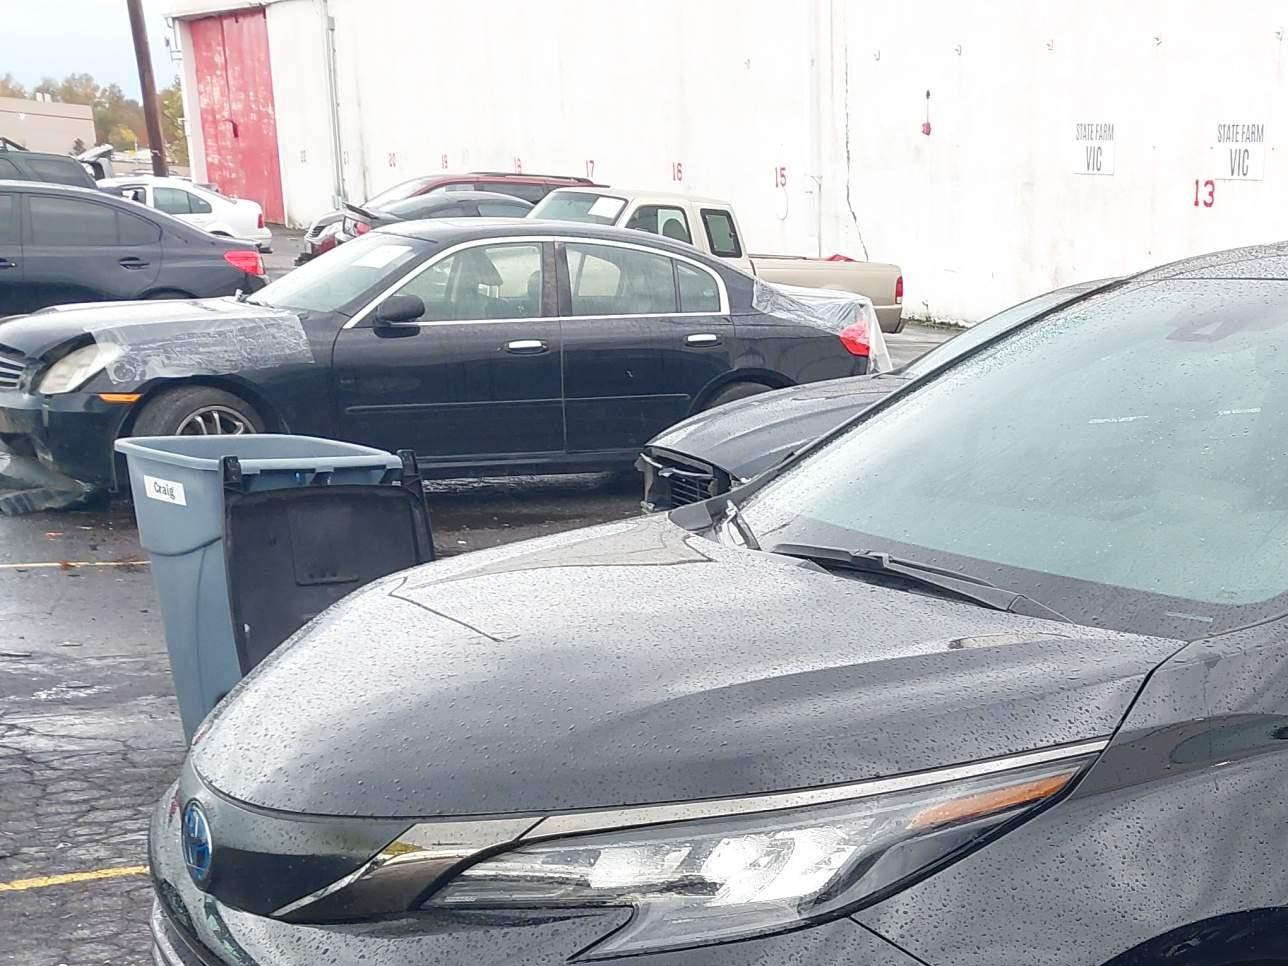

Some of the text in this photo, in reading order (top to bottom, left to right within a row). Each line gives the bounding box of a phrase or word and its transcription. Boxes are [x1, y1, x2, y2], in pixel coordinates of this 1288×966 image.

[1076, 123, 1114, 141] STATE FARM
[1217, 124, 1264, 143] STATE FARM
[585, 159, 595, 178] 17
[1085, 146, 1102, 172] VIC
[1229, 149, 1249, 177] VIC
[672, 162, 683, 181] 16
[775, 167, 787, 188] 15
[1193, 179, 1216, 207] 13
[153, 481, 176, 500] Craig
